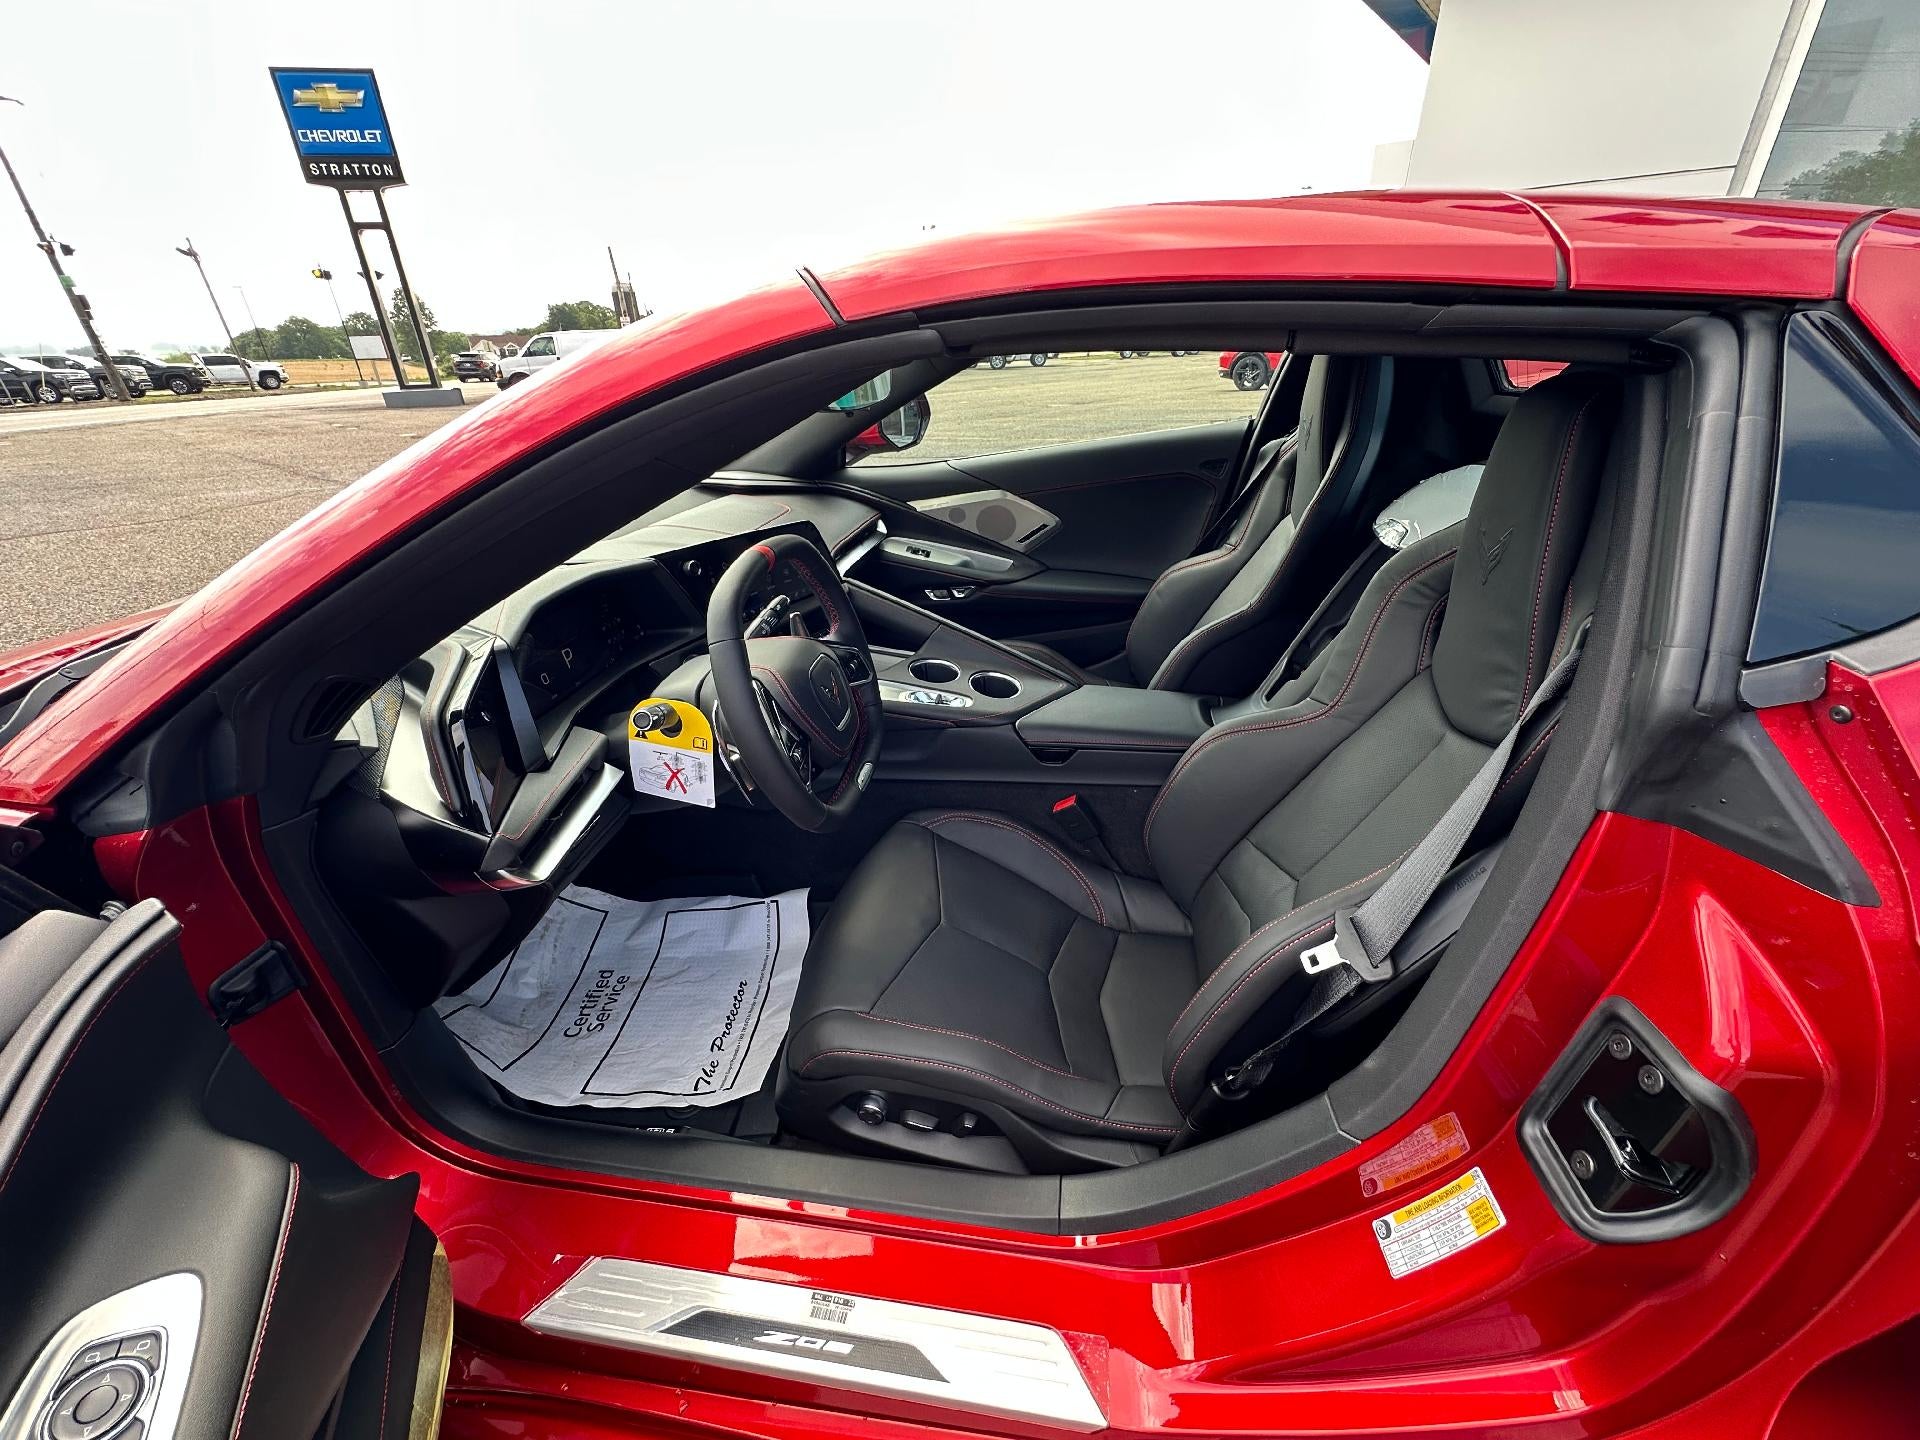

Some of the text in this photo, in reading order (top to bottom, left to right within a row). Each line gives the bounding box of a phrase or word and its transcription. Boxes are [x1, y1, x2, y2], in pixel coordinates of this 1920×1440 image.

[297, 129, 382, 143] CHEVROLET
[309, 163, 394, 176] STRATTON
[561, 648, 573, 669] P
[563, 970, 615, 1037] Certified
[586, 975, 631, 1032] Service
[693, 1059, 719, 1091] The
[710, 979, 748, 1053] Protector
[752, 1330, 855, 1355] Z0
